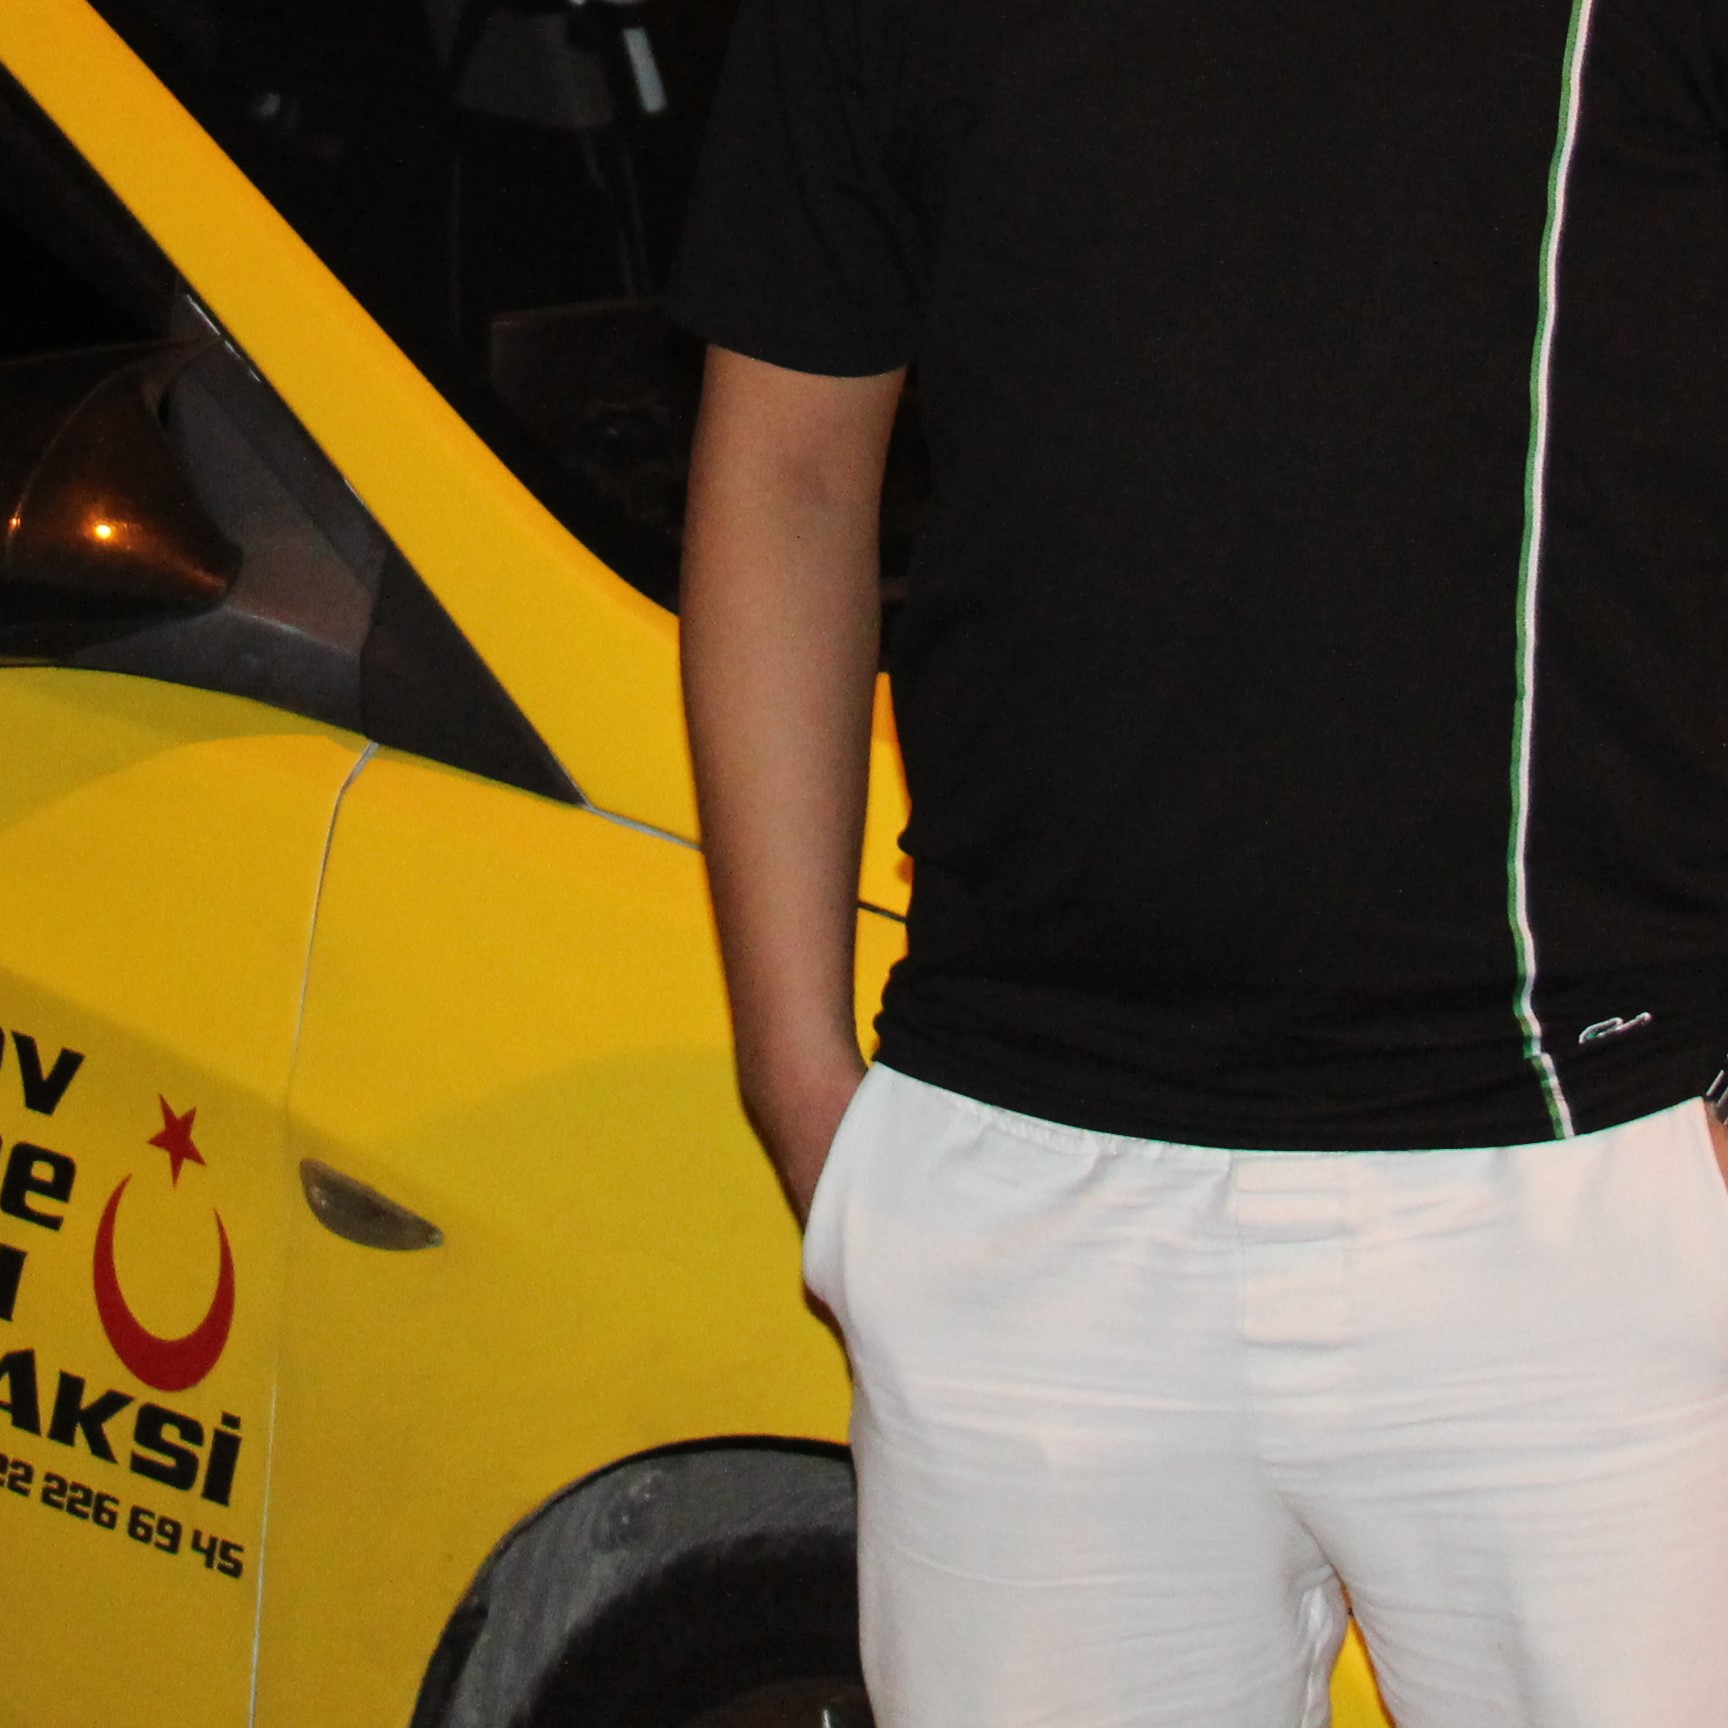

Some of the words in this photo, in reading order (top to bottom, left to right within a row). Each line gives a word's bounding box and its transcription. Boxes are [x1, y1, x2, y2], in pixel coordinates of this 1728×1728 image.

[40, 1471, 121, 1531] 226
[127, 1504, 183, 1556] 69
[191, 1528, 245, 1580] 45
